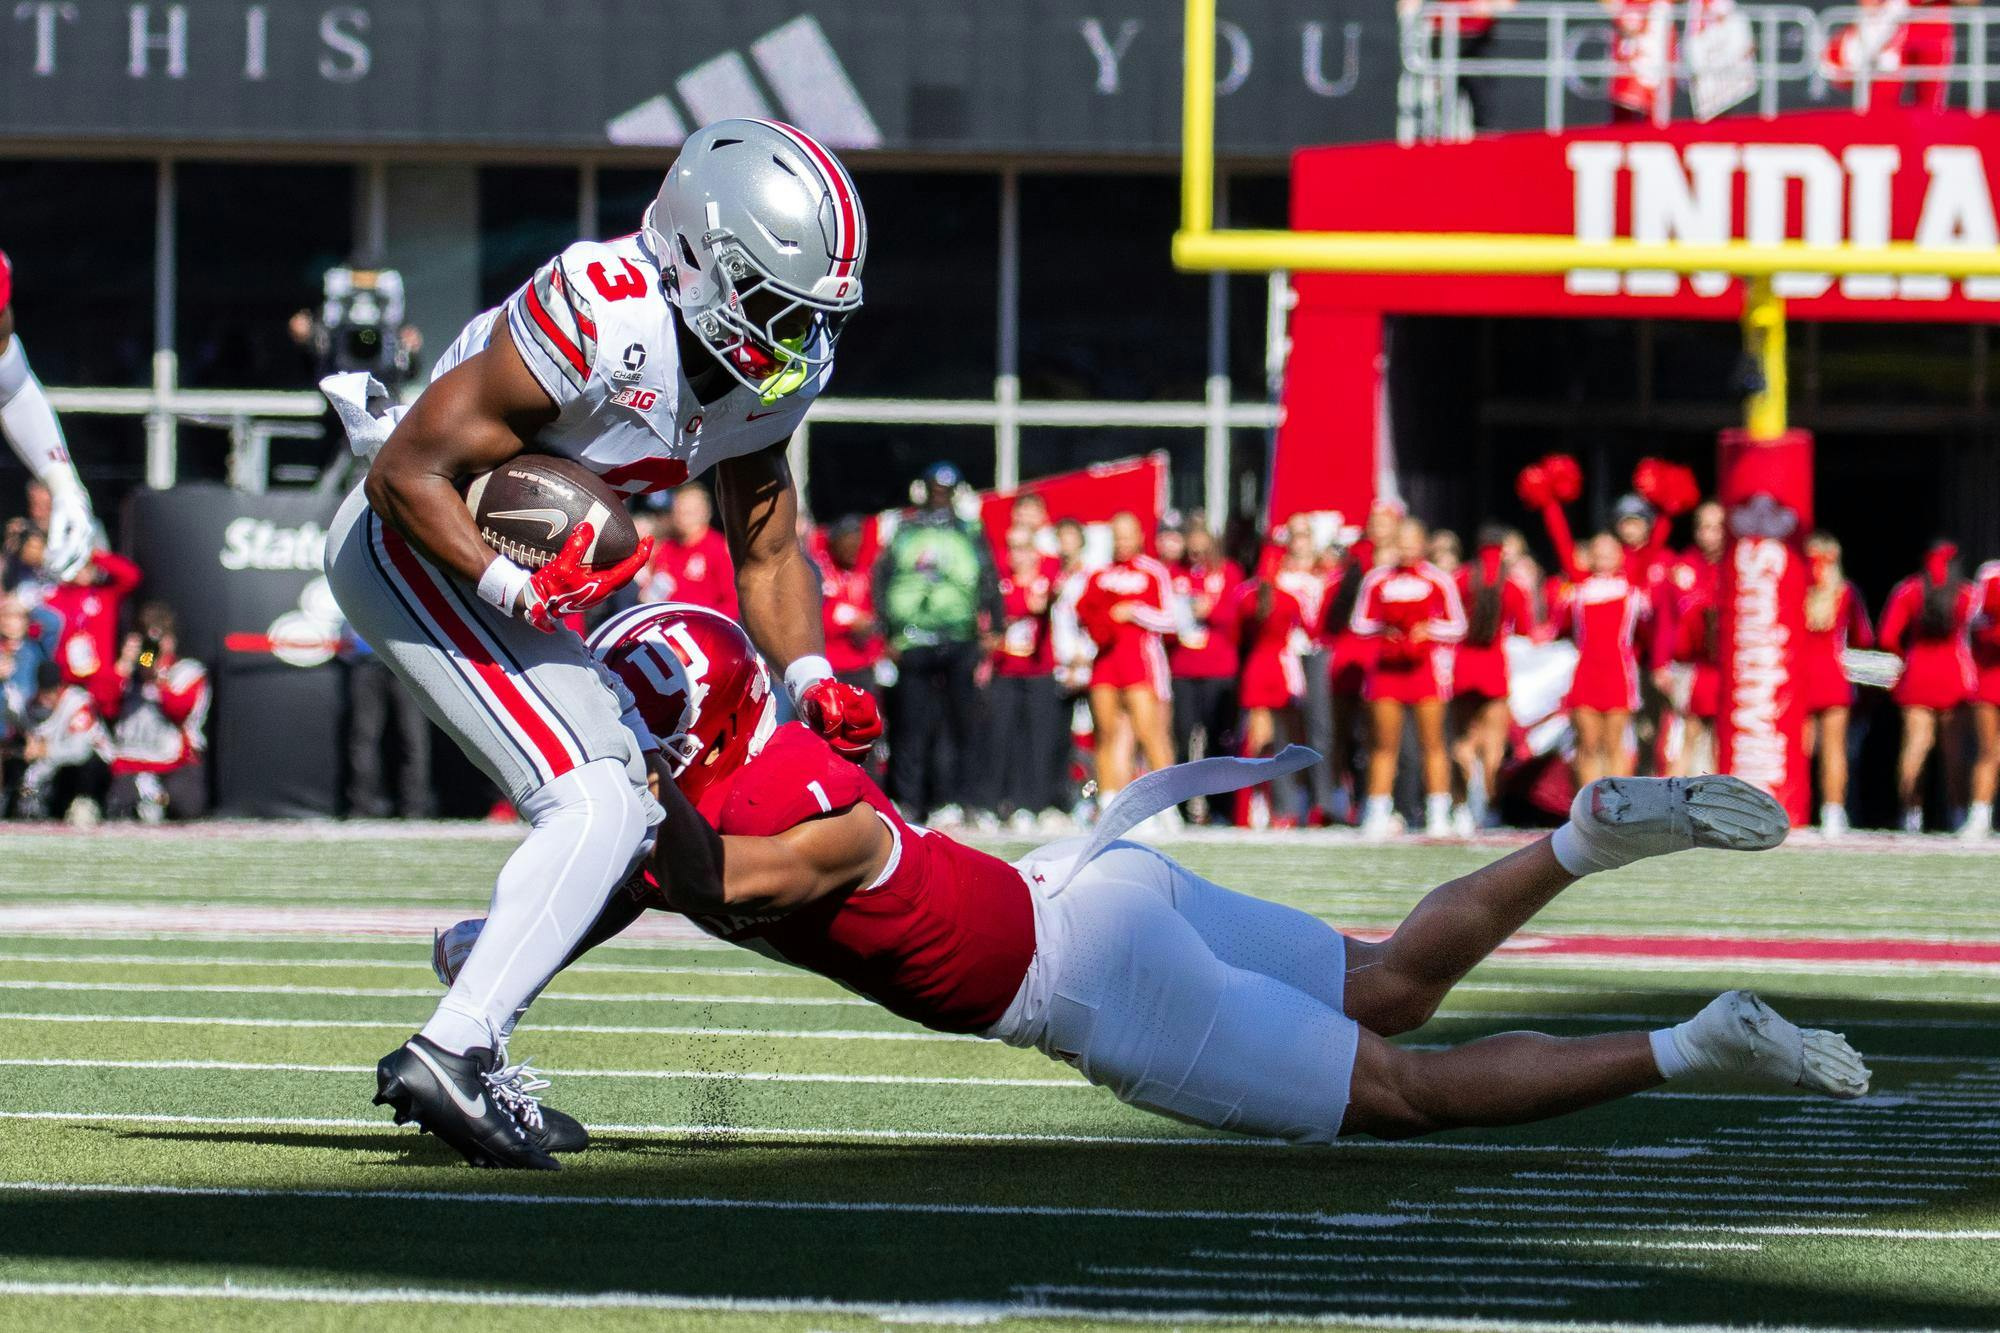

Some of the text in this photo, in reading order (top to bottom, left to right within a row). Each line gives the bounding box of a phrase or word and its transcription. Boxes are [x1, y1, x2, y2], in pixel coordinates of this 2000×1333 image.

[13, 3, 371, 83] THIS
[586, 257, 647, 302] 3
[613, 370, 642, 381] CHASE
[1730, 537, 1790, 801] Smithvill
[806, 780, 832, 813] 1
